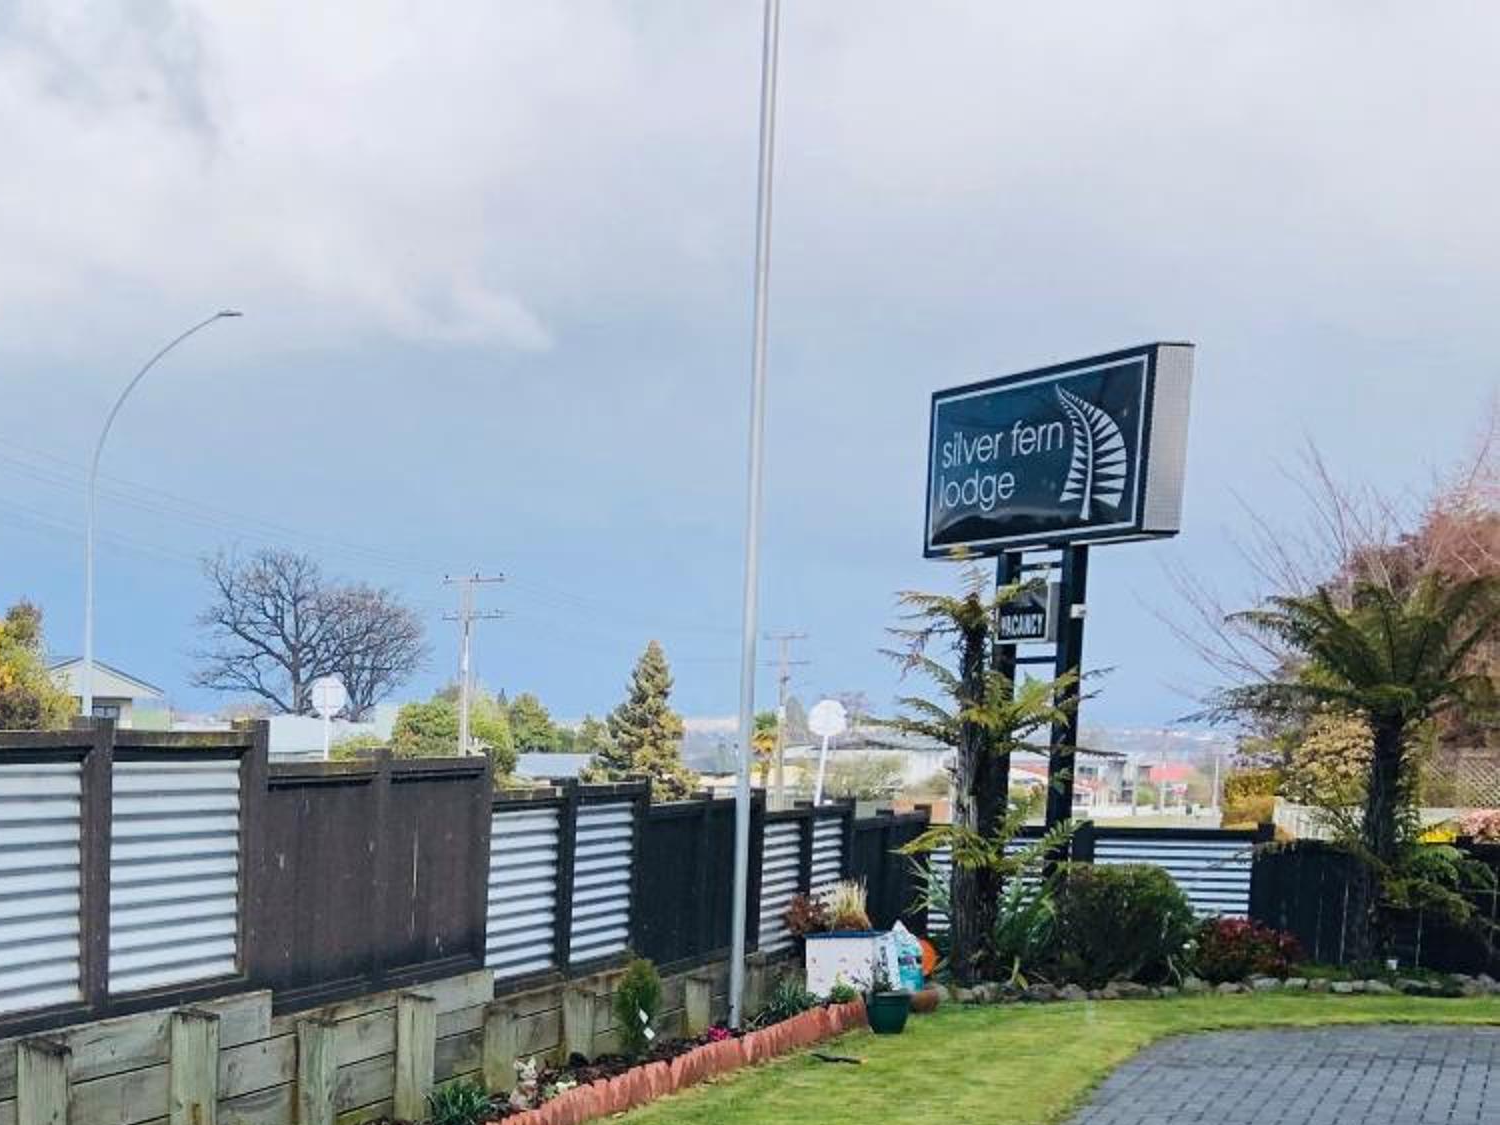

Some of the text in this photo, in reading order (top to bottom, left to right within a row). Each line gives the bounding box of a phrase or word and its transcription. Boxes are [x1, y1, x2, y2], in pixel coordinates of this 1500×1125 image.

[942, 420, 1064, 469] silver fern
[939, 469, 1016, 511] lodge
[1001, 613, 1044, 636] VACANCY
